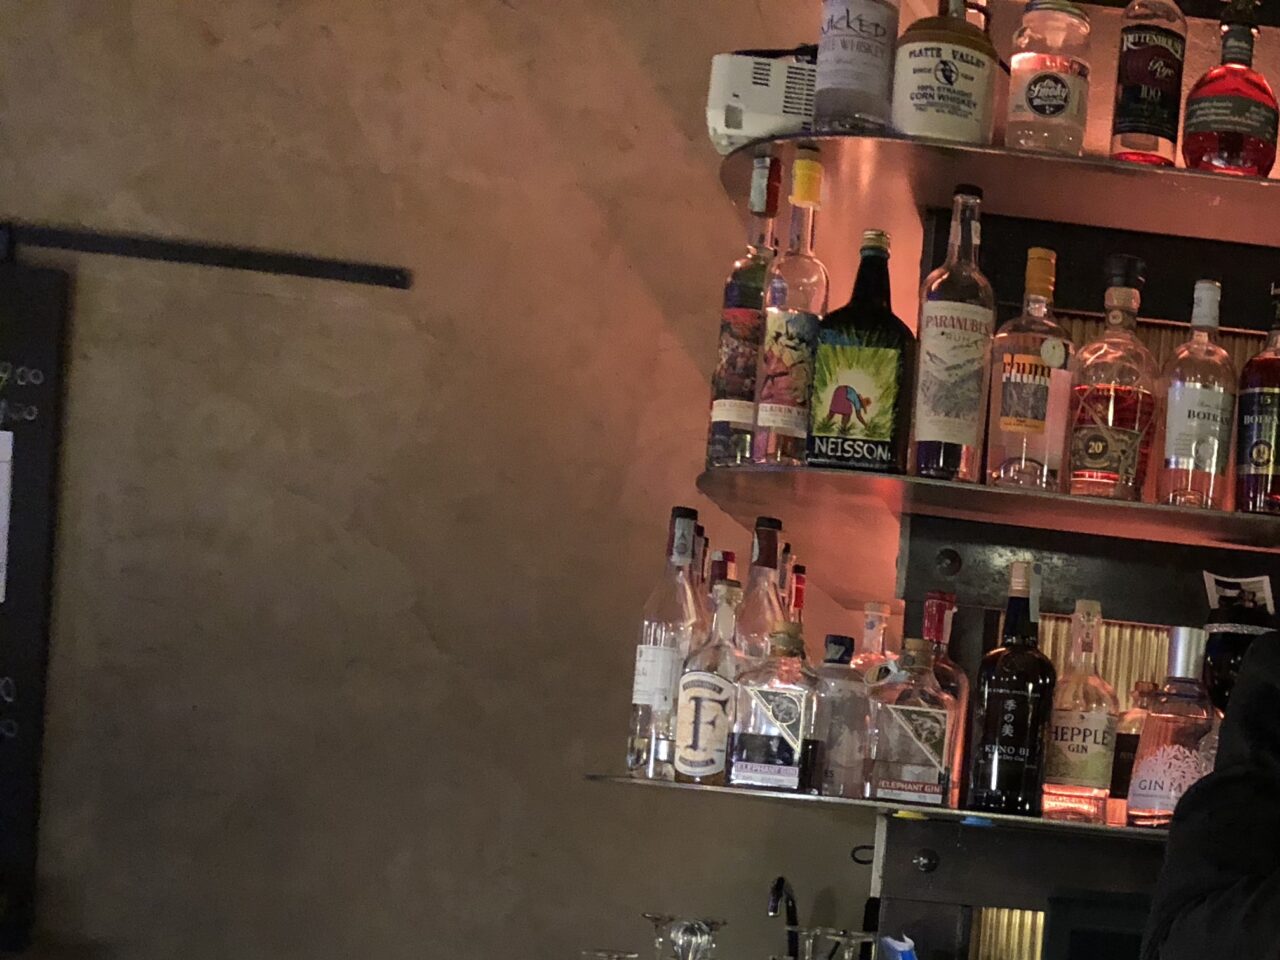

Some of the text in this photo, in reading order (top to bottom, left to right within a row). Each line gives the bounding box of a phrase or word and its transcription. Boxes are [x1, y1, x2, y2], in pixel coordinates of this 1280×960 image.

[814, 437, 889, 461] NEISSON
[1051, 726, 1110, 745] HEPPLE
[1067, 744, 1088, 754] GIN
[924, 785, 940, 793] GIN
[1139, 779, 1164, 791] GIN
